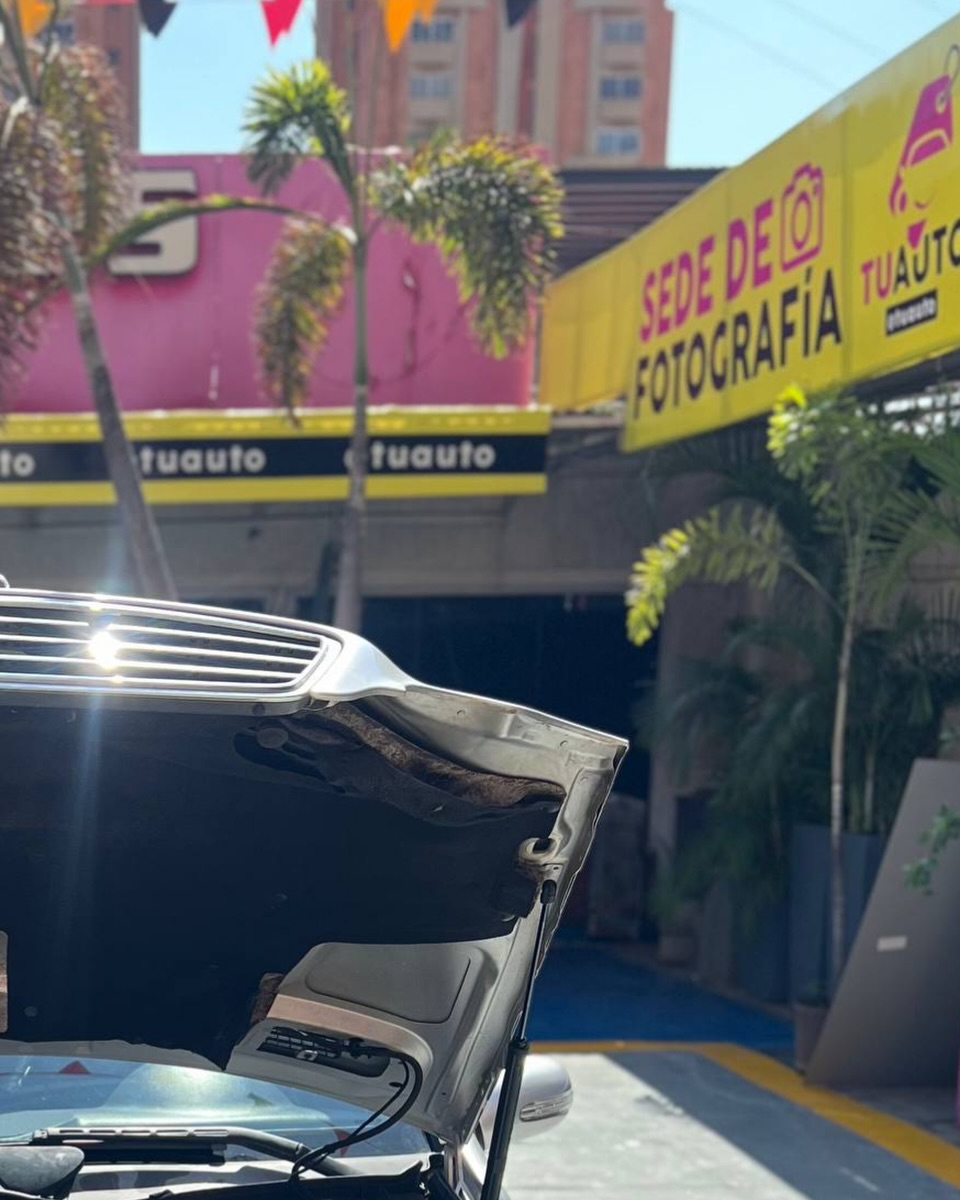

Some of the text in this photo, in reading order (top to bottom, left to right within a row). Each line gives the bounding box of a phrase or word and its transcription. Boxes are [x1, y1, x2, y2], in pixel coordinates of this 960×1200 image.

[633, 265, 842, 420] FOTOGRAFÍA
[640, 198, 774, 344] SEDE DE
[130, 444, 267, 475] tuauto
